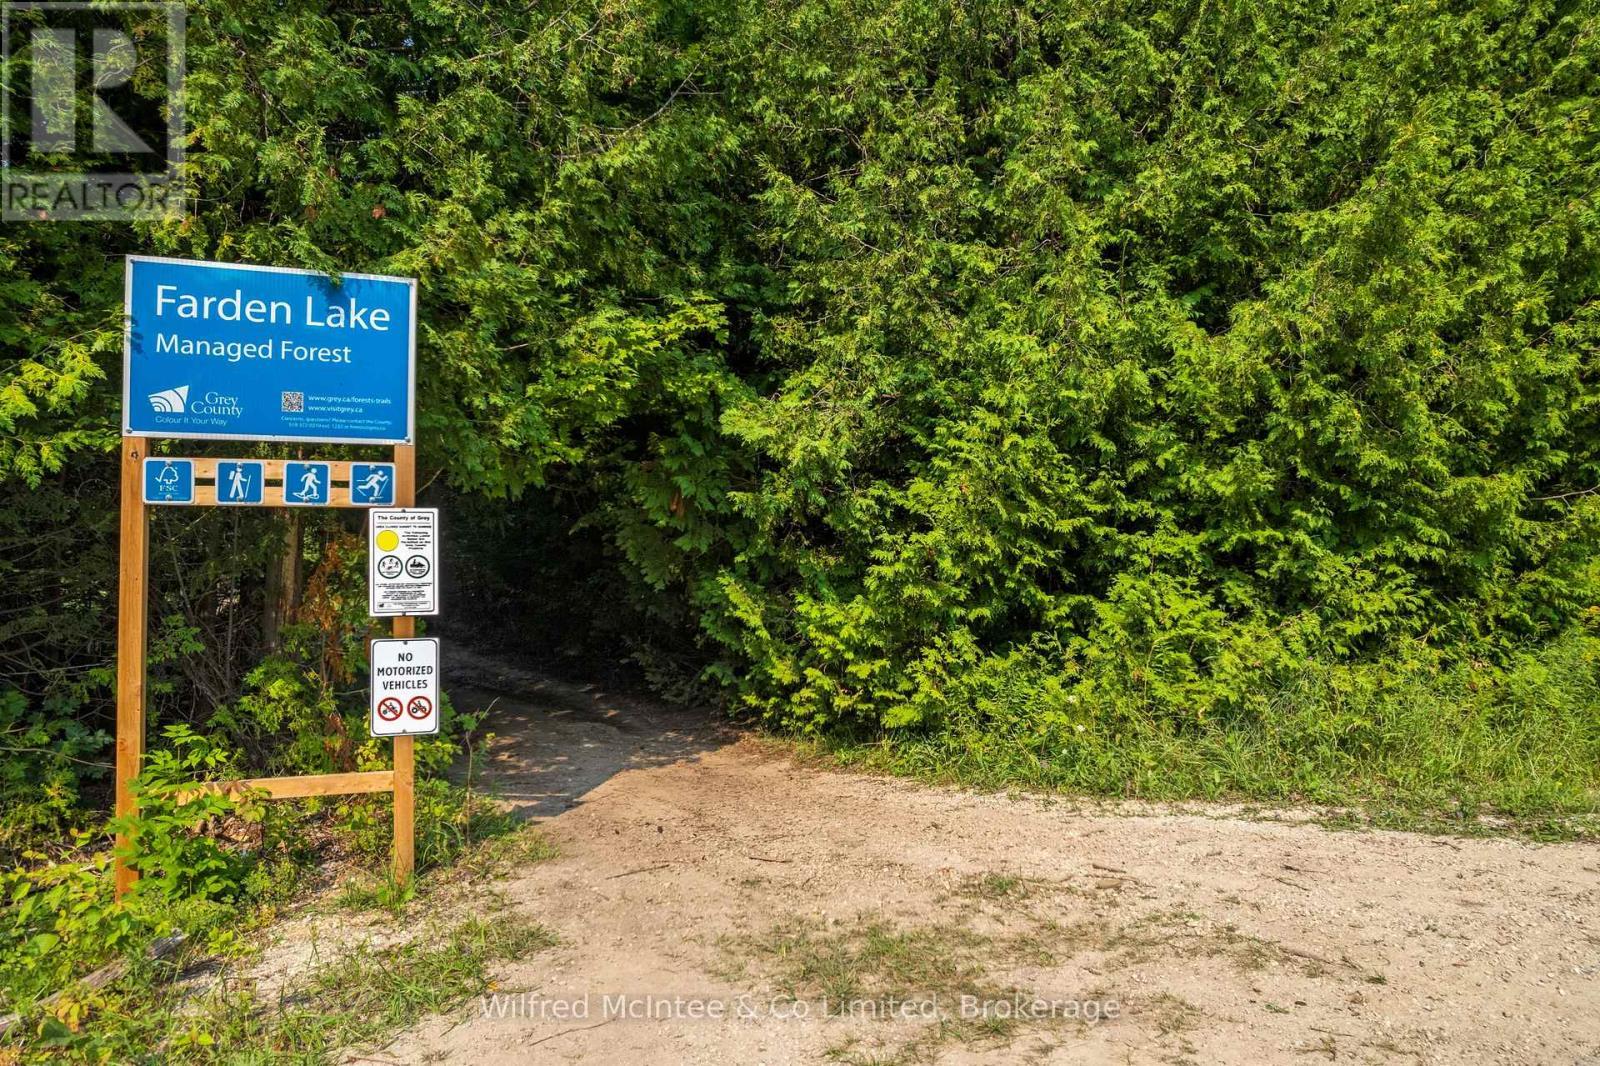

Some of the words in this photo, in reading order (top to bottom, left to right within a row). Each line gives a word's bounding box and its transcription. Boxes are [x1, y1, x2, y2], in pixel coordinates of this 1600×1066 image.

[155, 284, 292, 325] Farden
[306, 295, 391, 332] Lake
[155, 333, 273, 362] Managed
[281, 340, 352, 364] Forest
[205, 391, 239, 407] Grey
[191, 400, 243, 418] County
[307, 405, 364, 415] www.visitgrey.ca
[155, 415, 181, 424] Colour
[183, 416, 189, 424] It
[191, 417, 208, 425] Your
[210, 417, 228, 427] Way
[159, 484, 178, 492] FSC
[398, 652, 413, 662] NO
[377, 665, 433, 676] MOTORIZED
[382, 679, 428, 690] VEHICLES
